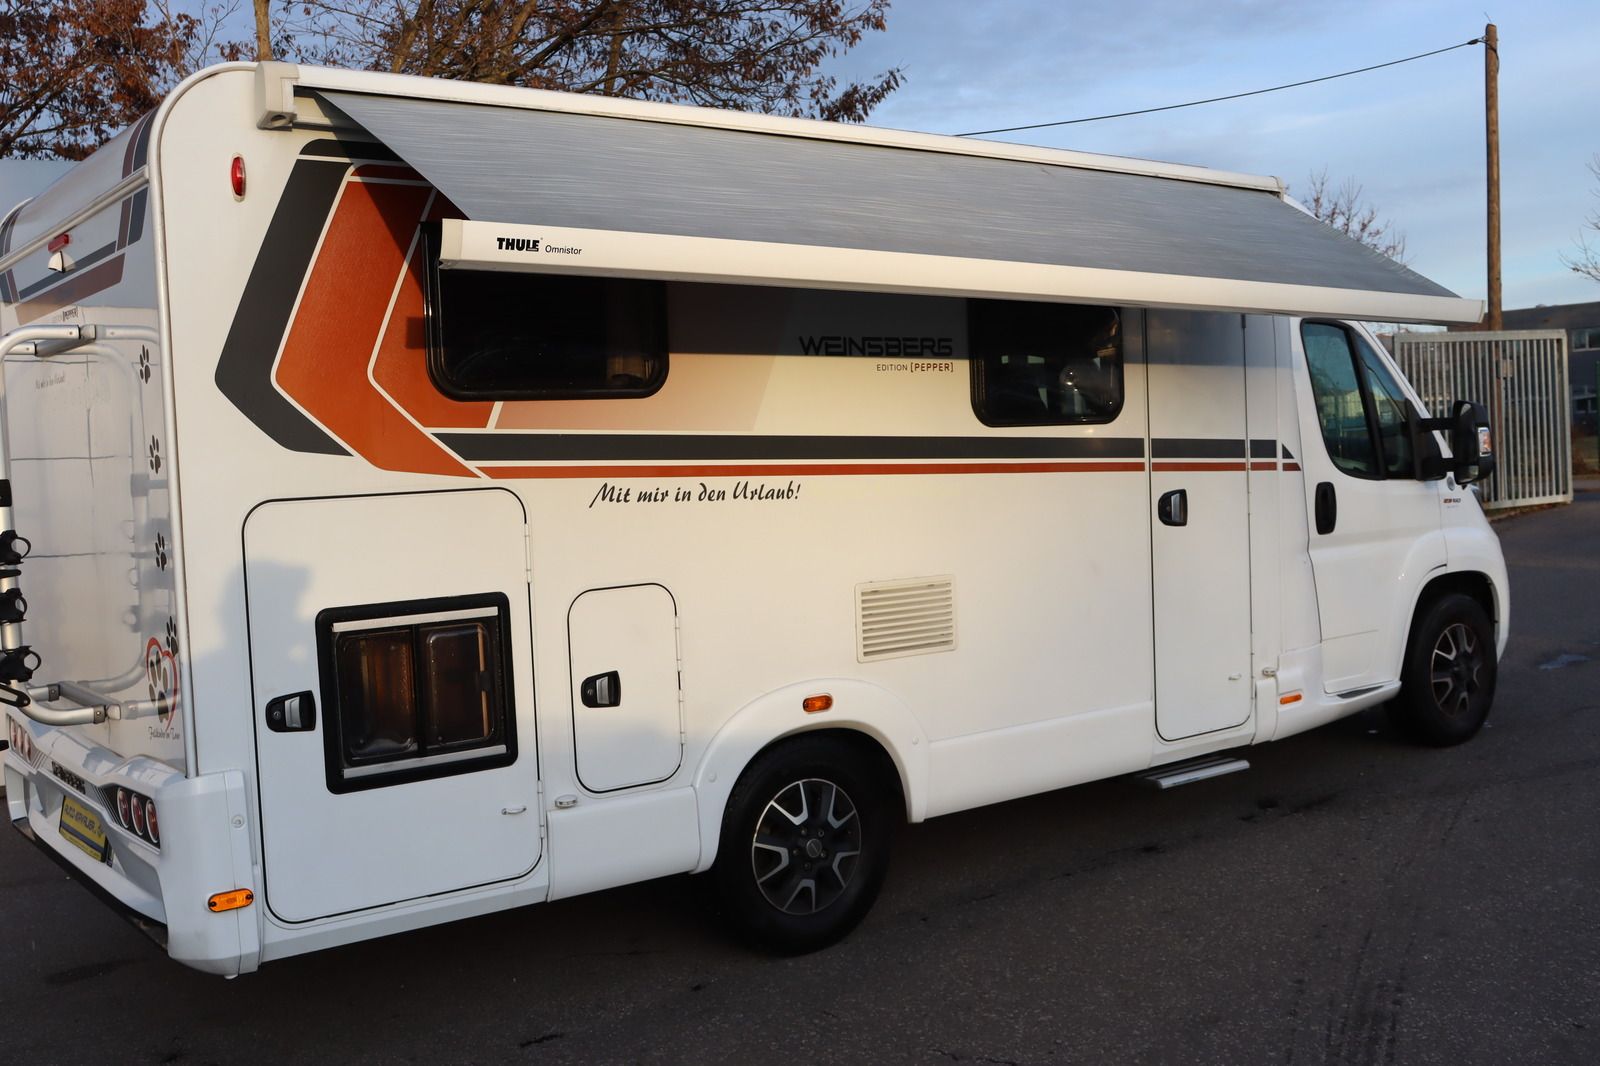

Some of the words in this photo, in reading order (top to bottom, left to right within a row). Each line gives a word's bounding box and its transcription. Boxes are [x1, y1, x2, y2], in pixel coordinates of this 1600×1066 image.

[497, 237, 540, 252] THULE
[545, 244, 582, 255] Omnistor
[799, 336, 953, 357] WEINSBERG
[876, 363, 908, 372] EDITION
[910, 362, 954, 373] [PEPPER]
[589, 482, 630, 508] Mit
[637, 487, 669, 503] mir
[674, 487, 692, 502] in
[698, 482, 726, 502] den
[732, 480, 801, 501] Urlaub!
